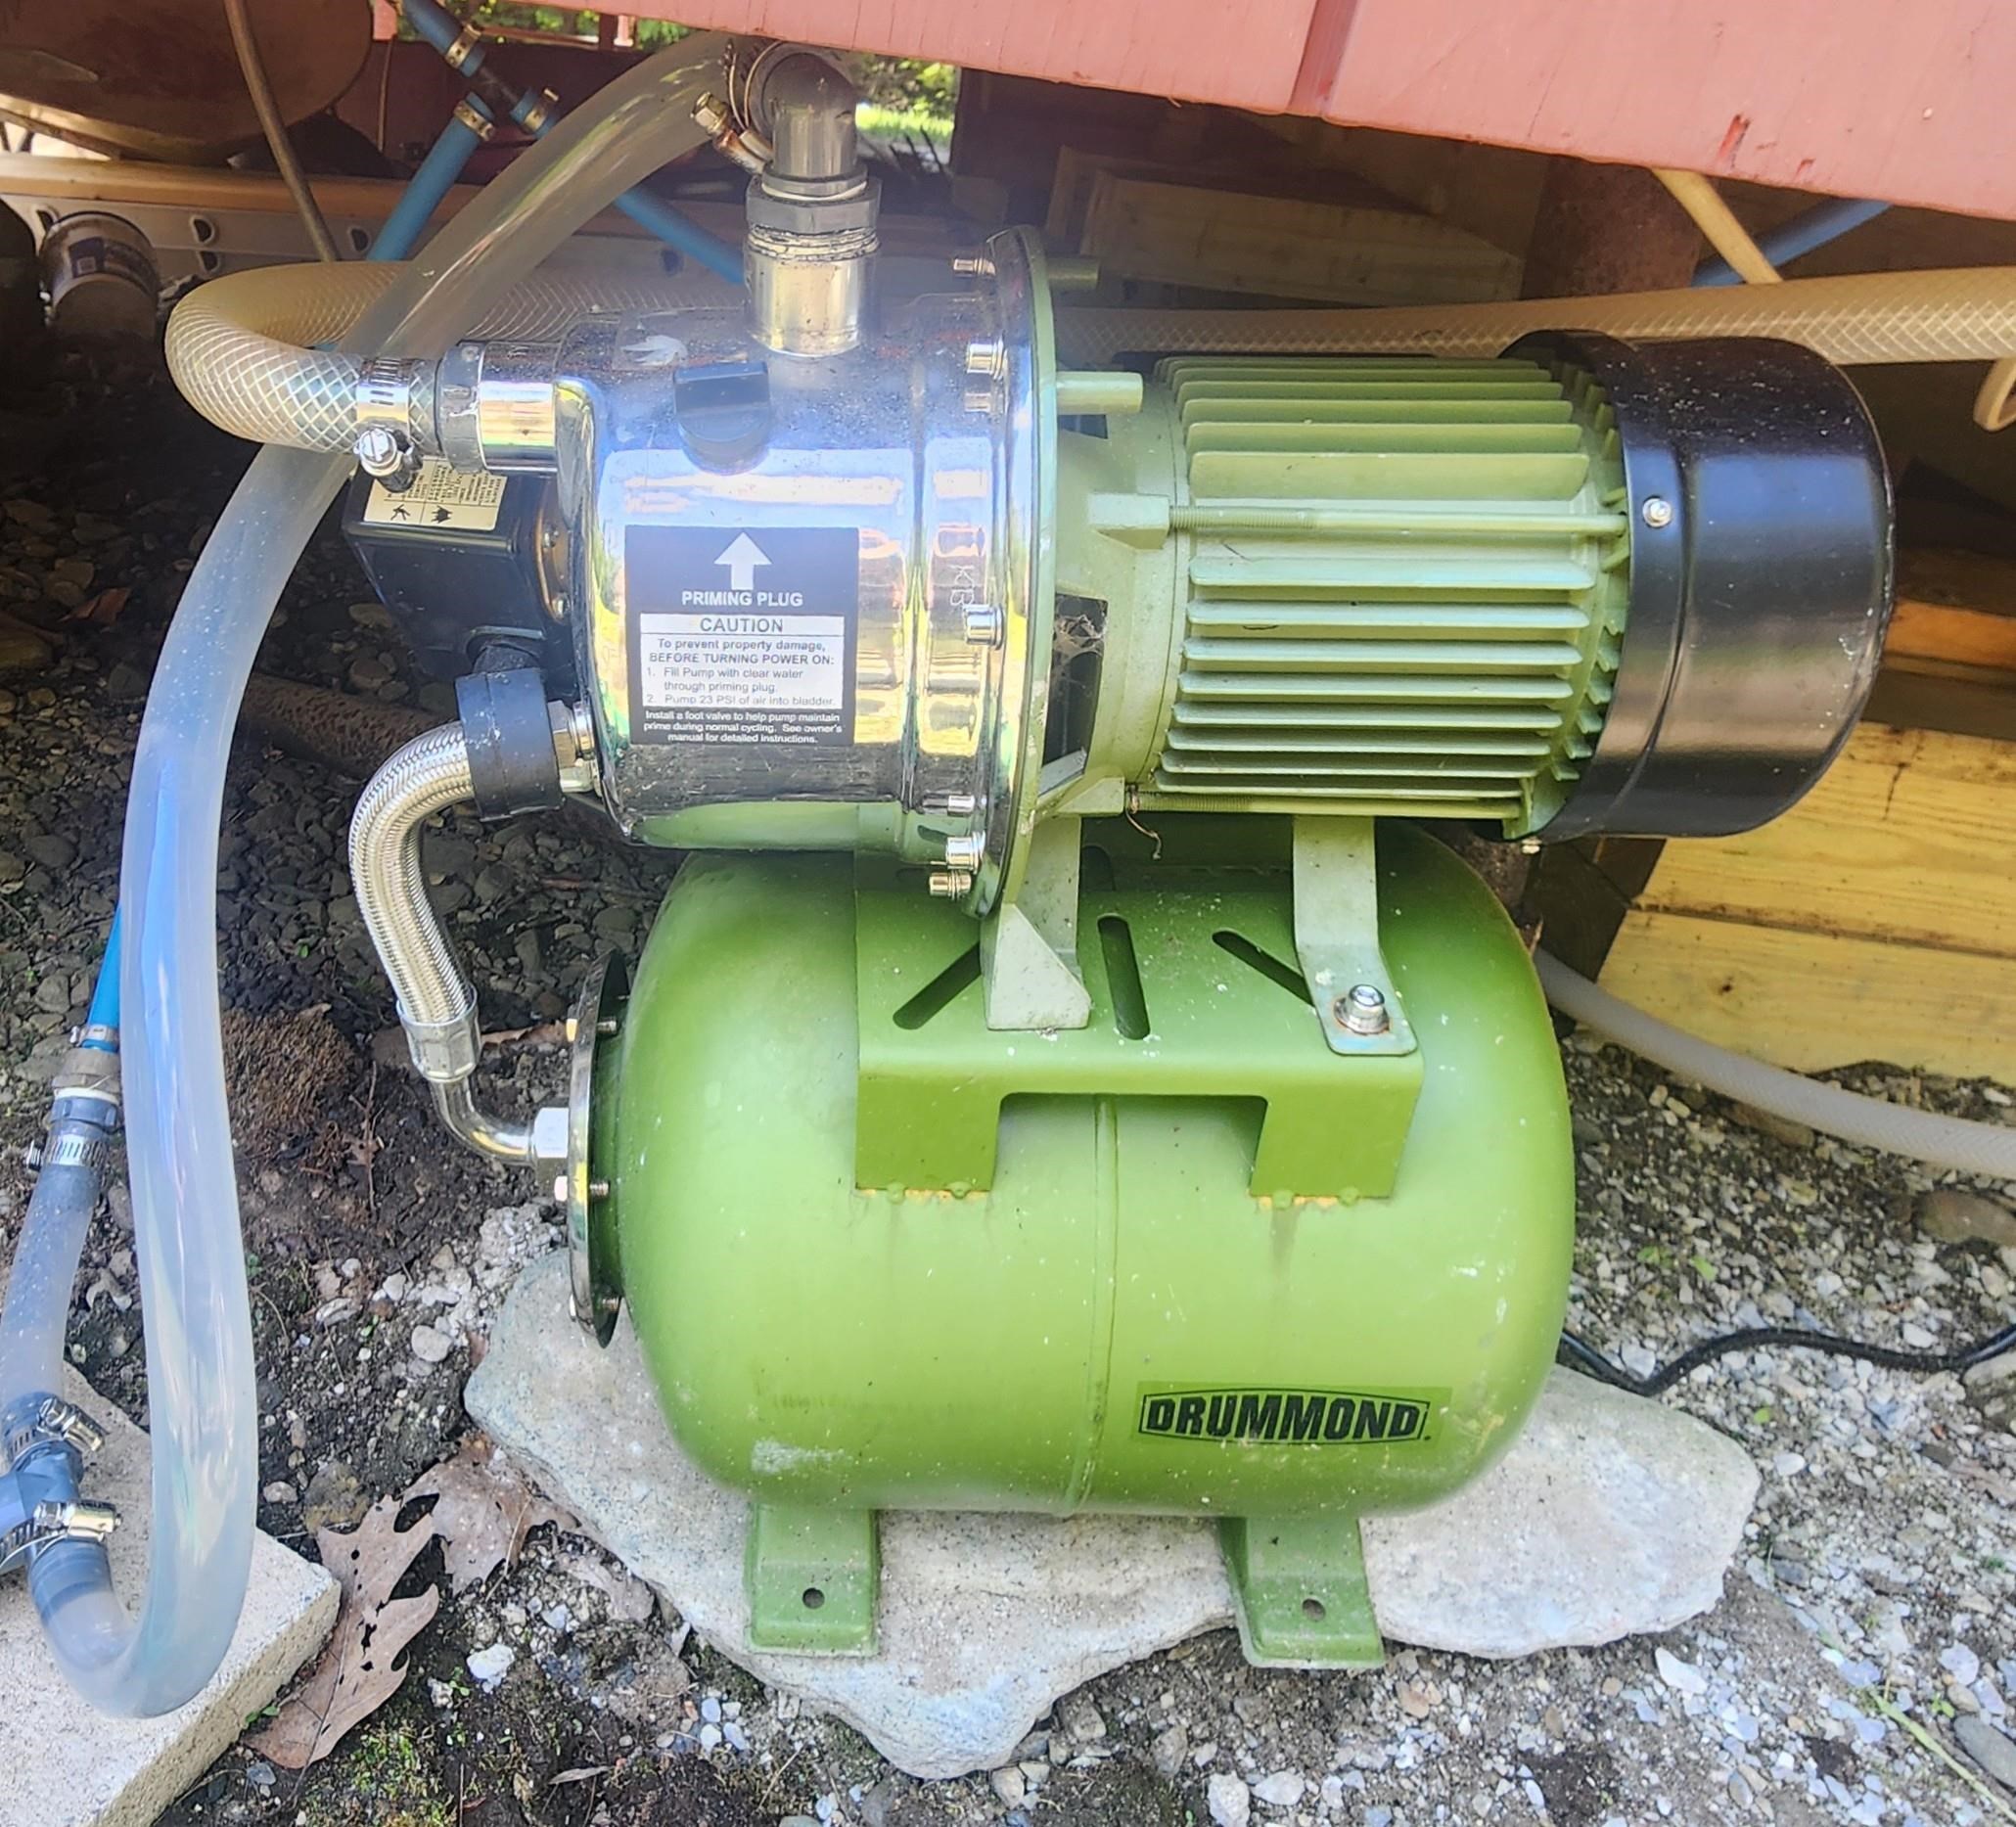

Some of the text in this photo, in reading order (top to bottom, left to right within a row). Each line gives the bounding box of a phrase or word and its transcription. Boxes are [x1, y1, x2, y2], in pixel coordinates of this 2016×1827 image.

[681, 590, 802, 607] PRIMING PLUG
[700, 617, 783, 632] CAUTION
[658, 638, 826, 653] To prevent property damage,
[649, 652, 835, 665] BEFORE TURNING POWER ON:
[647, 666, 803, 678] 1. Fill Pump with clear water
[664, 681, 705, 693] through
[709, 682, 749, 694] priming
[665, 694, 697, 706] Pump
[700, 695, 713, 705] 23
[716, 695, 736, 705] PSI
[738, 696, 750, 705] of
[753, 696, 766, 706] air
[769, 696, 790, 706] into
[792, 697, 836, 707] bladder.
[646, 710, 674, 719] Install
[685, 710, 705, 720] foot
[706, 711, 732, 721] valve
[733, 712, 744, 721] to
[746, 712, 767, 723] help
[768, 713, 797, 723] pump
[799, 713, 840, 722] maintain
[644, 721, 843, 734] prime during normal cycling. See owner's
[667, 733, 704, 742] manual
[720, 734, 758, 743] detailed
[760, 734, 819, 744] instructions.
[1145, 1394, 1420, 1440] DRUMMOND
